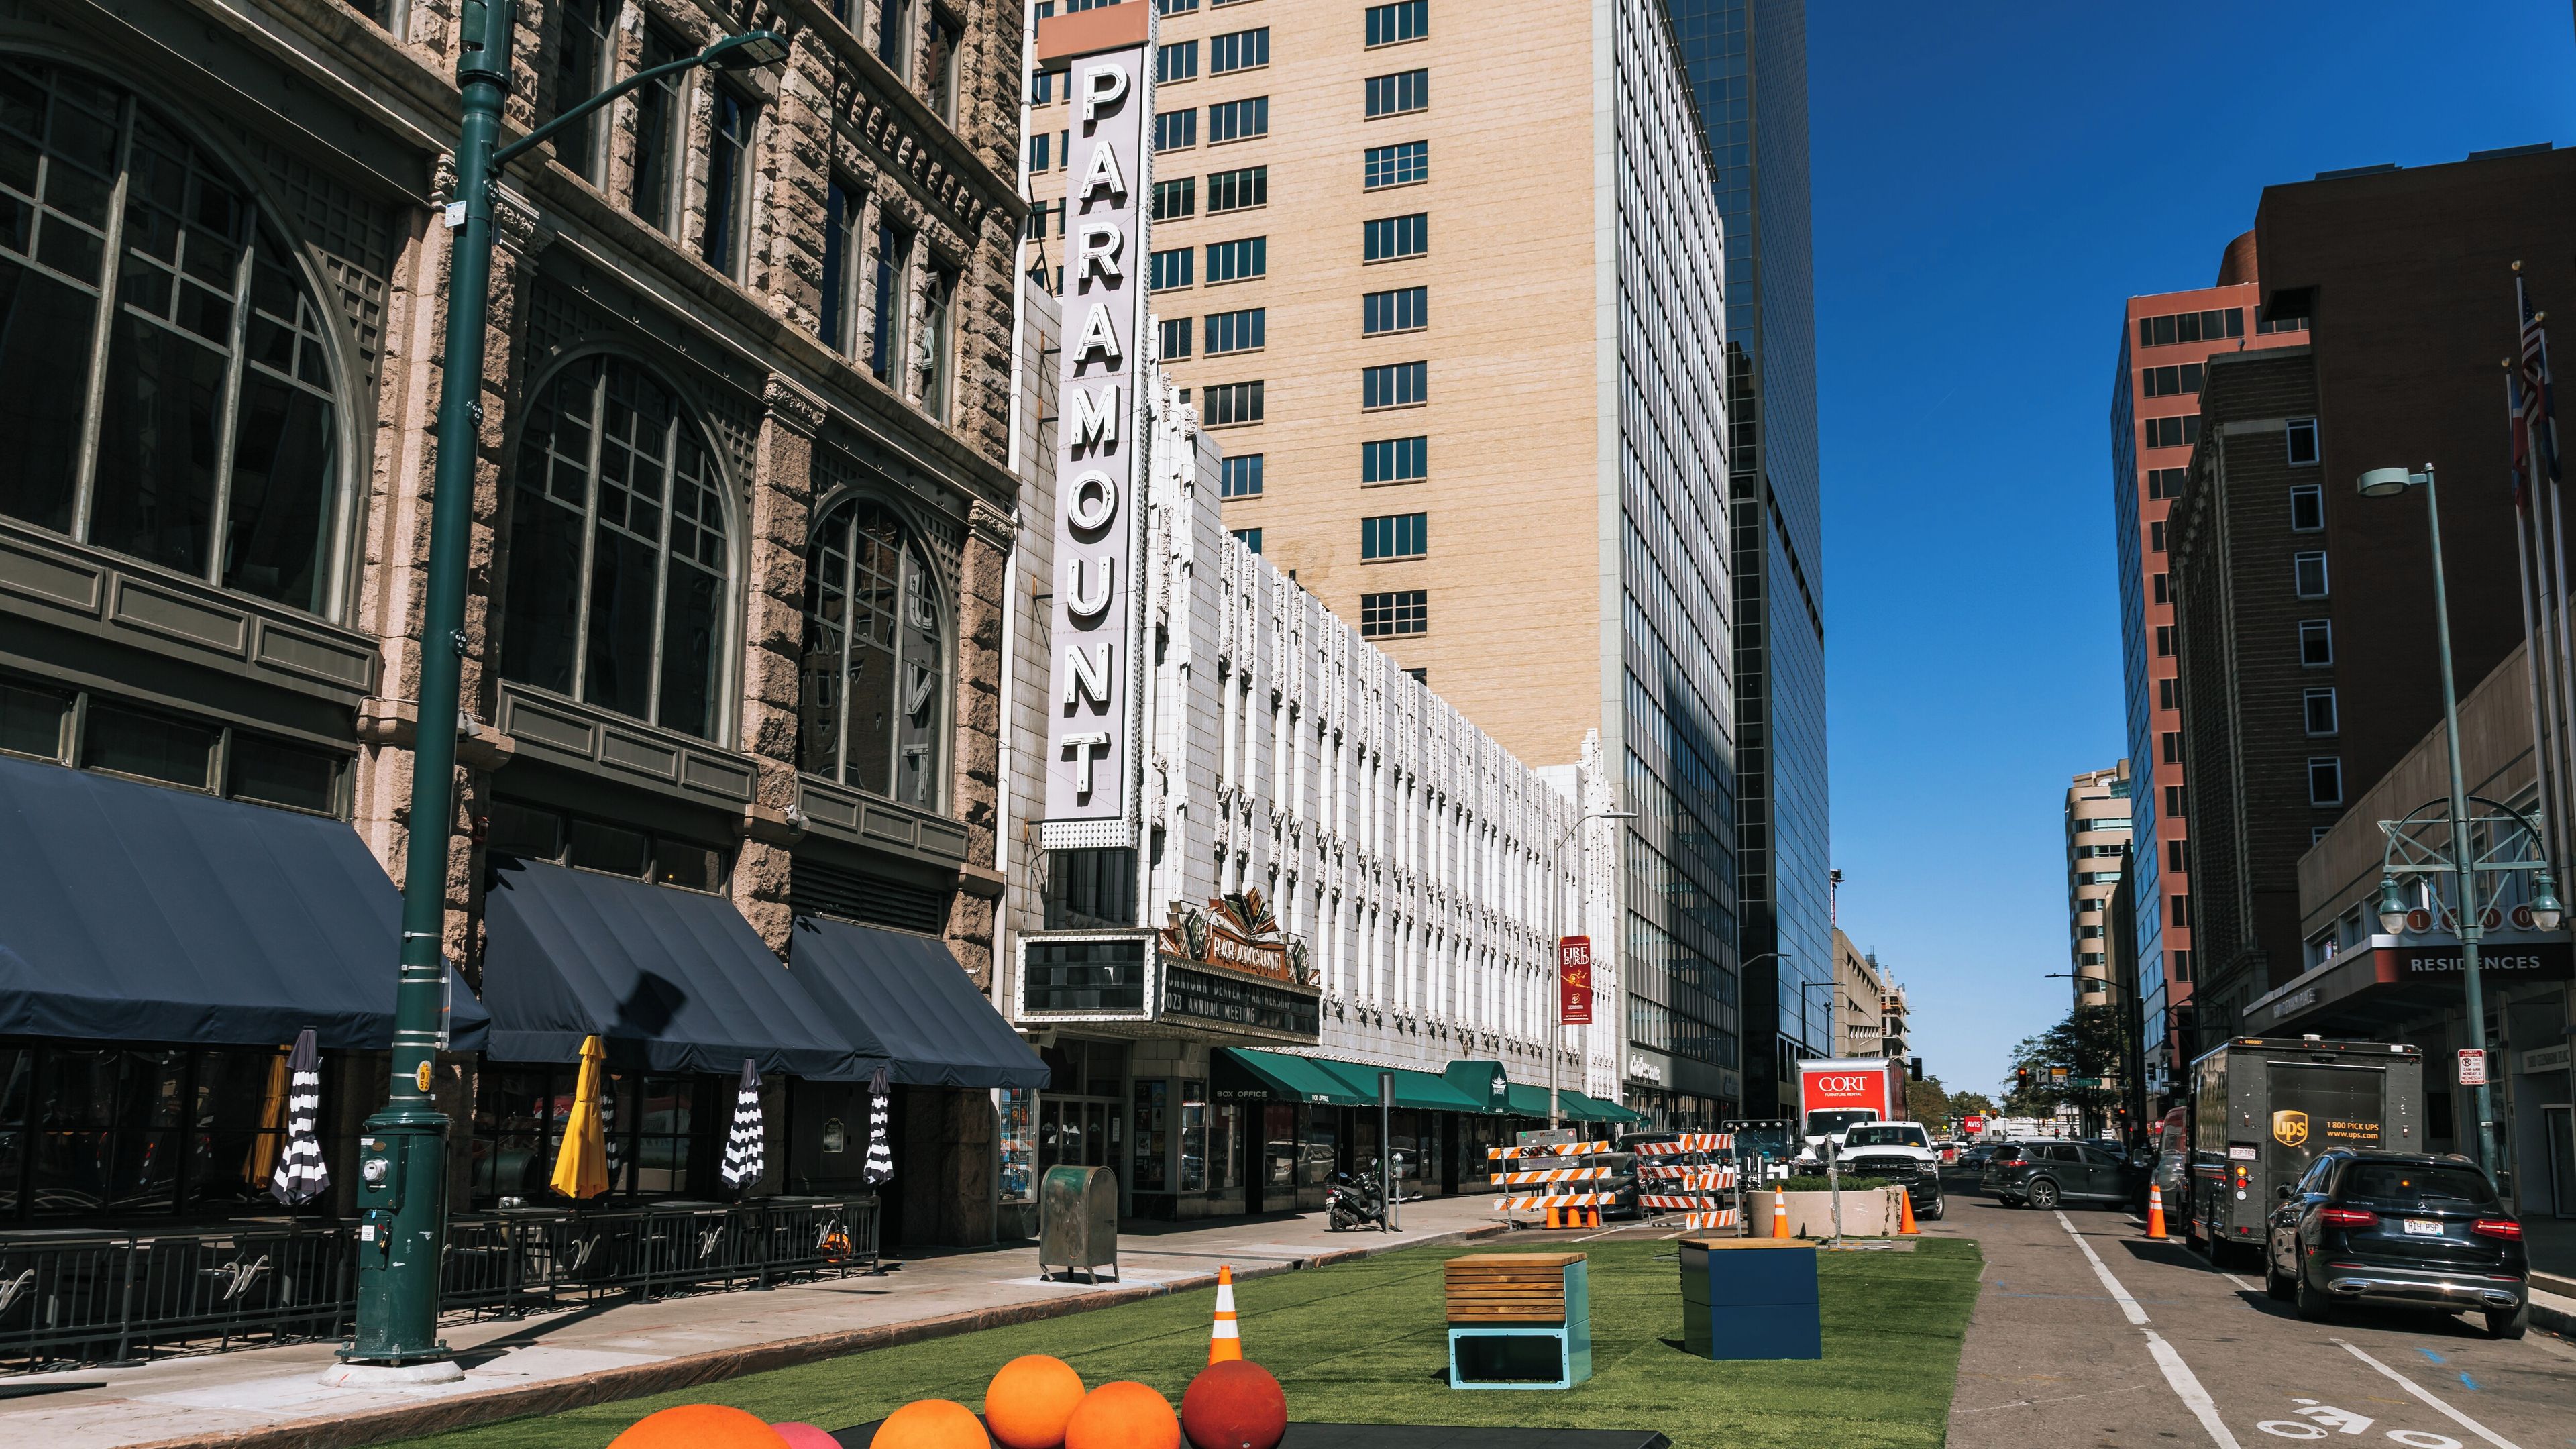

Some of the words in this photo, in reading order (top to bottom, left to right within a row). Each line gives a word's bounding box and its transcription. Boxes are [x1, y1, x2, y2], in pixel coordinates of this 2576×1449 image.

[1060, 64, 1131, 794] PARAMOUNT
[1214, 937, 1281, 971] PARAMOUNT
[1564, 947, 1587, 957] FIRE
[1564, 956, 1589, 967] BIRD
[1168, 969, 1208, 994] OWNTOWN
[1214, 979, 1241, 1000] DENVER
[1247, 987, 1291, 1010] PARTNERSHIP
[1165, 992, 1181, 1011] 023
[1188, 996, 1219, 1017] ANNUAL
[1225, 1005, 1255, 1023] MEETING
[1819, 1076, 1868, 1092] CORT
[2276, 1121, 2306, 1141] ups
[2327, 1130, 2379, 1139] www.ups.com
